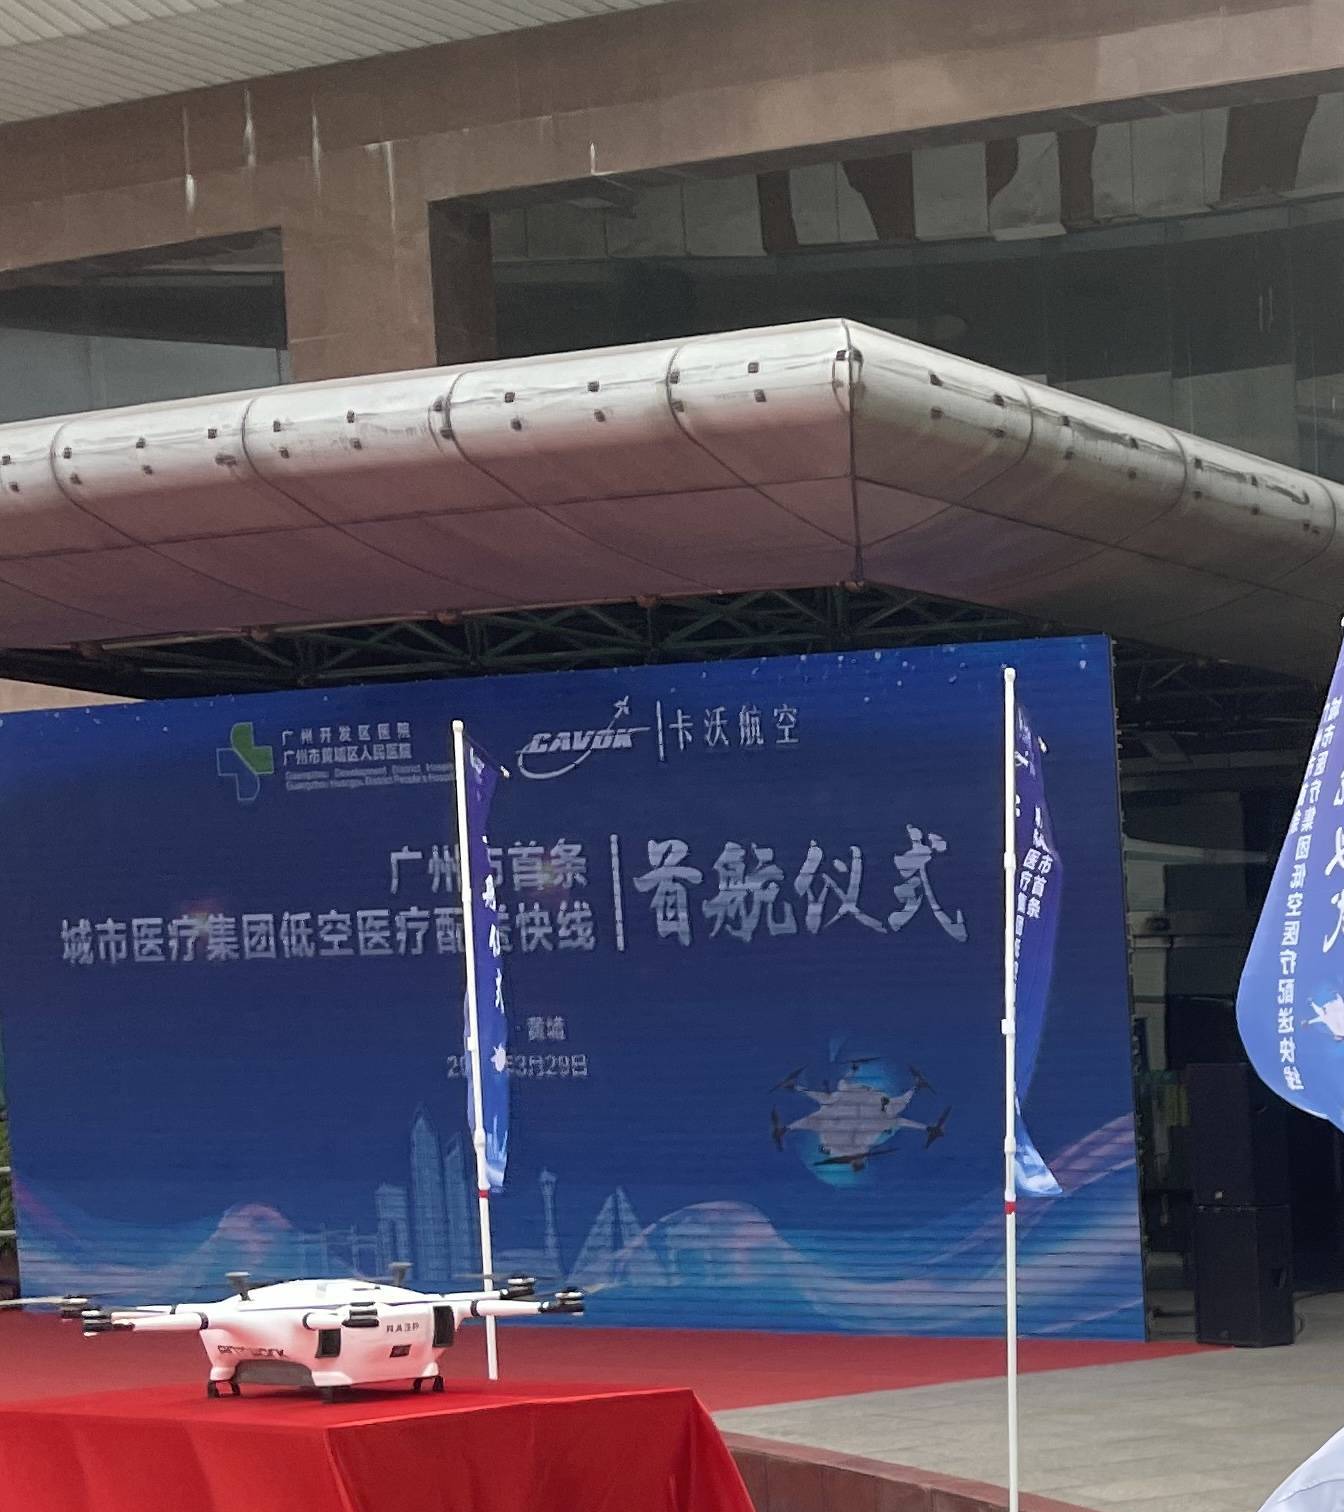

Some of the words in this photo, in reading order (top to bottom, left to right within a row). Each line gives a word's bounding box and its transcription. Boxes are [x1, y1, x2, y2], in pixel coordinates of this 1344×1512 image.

[668, 703, 800, 750] 卡沃航空
[633, 824, 969, 946] 首航仪式
